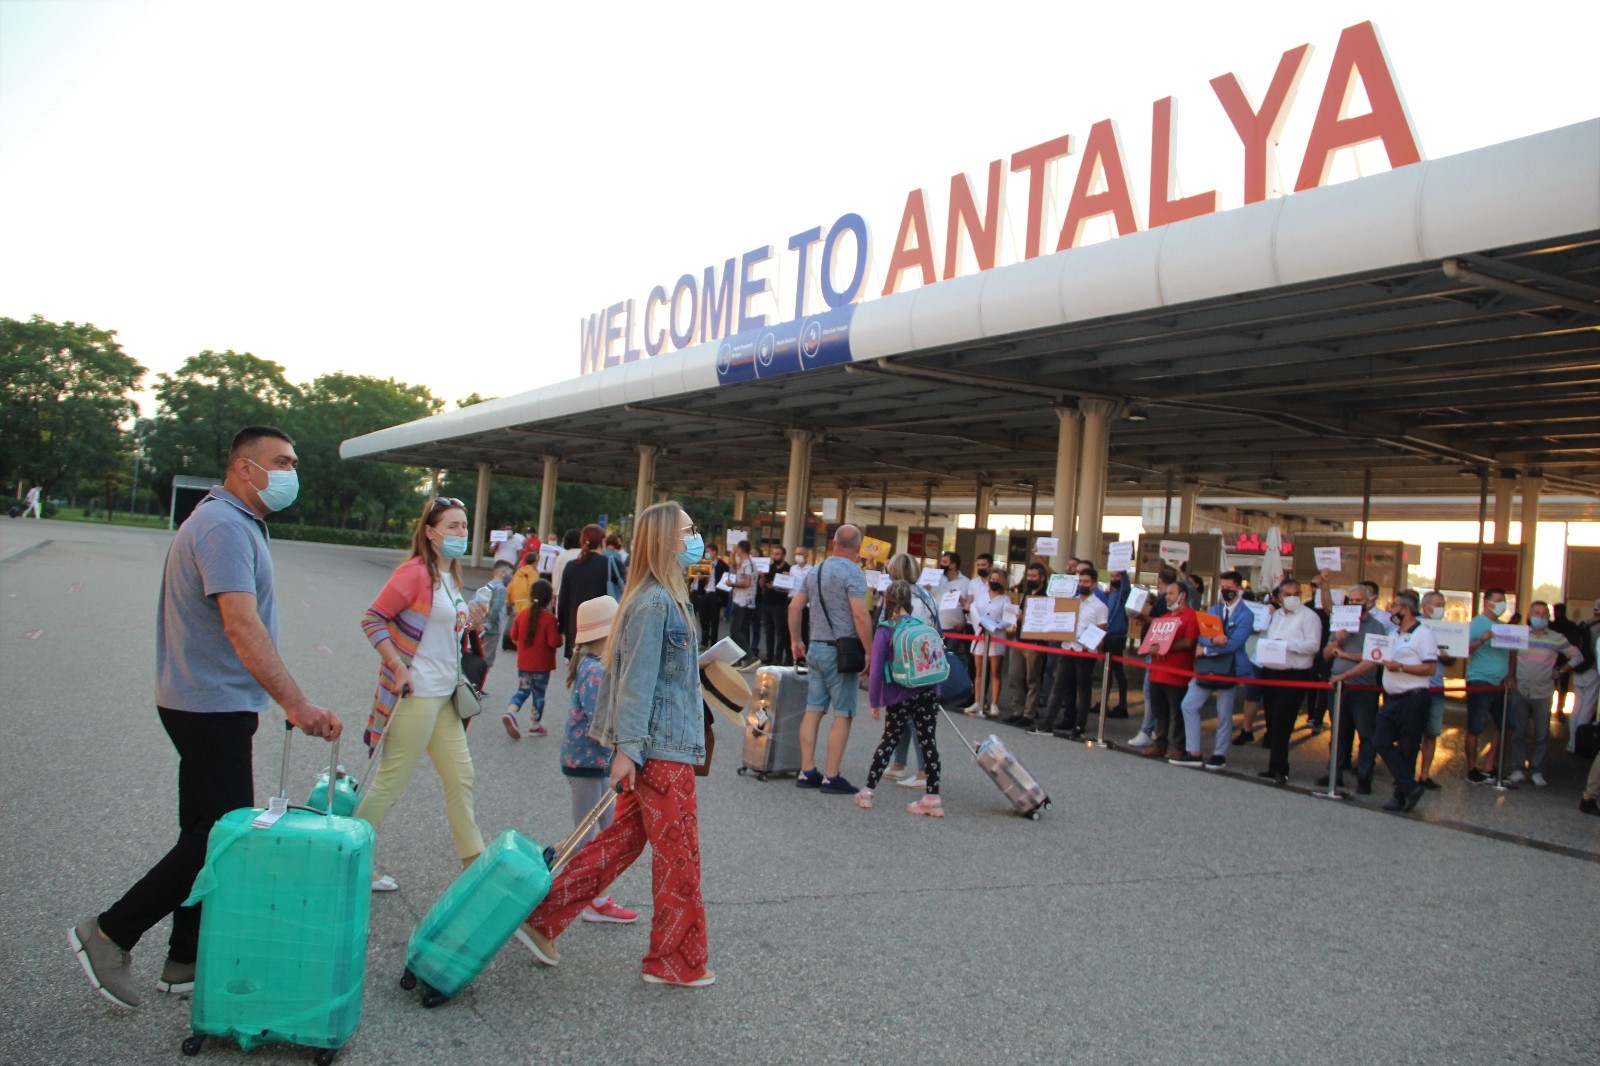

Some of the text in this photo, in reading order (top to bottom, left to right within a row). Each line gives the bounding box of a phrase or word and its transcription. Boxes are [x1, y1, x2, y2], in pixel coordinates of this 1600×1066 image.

[580, 19, 1425, 376] WELCOME TO ANTALYA
